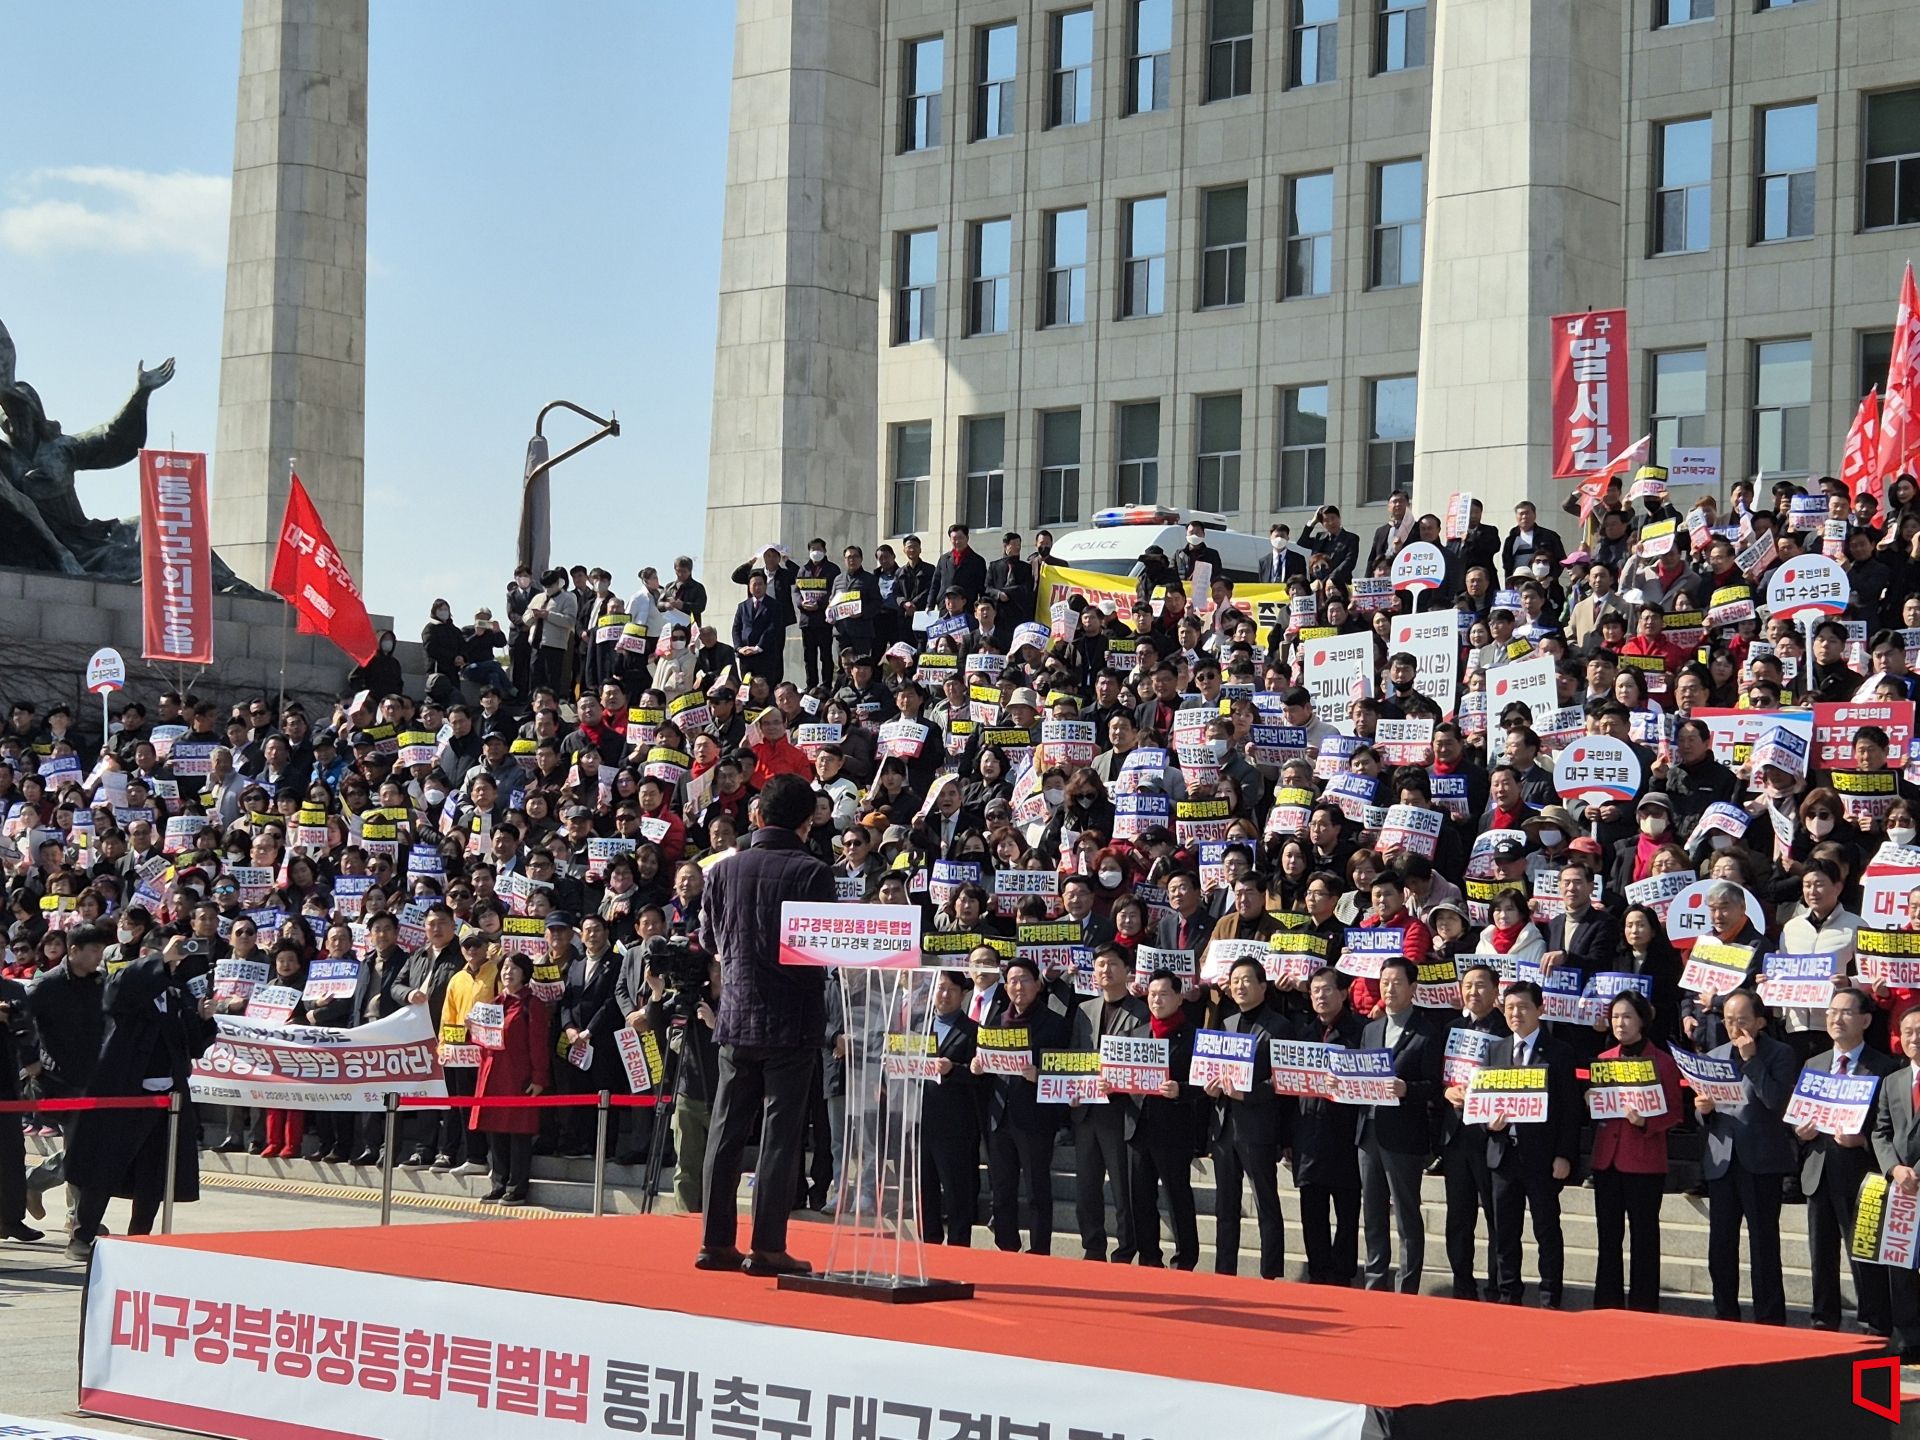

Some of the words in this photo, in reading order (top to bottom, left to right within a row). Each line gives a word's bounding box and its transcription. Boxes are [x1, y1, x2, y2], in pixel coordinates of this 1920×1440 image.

[1567, 317, 1612, 336] 대구
[1568, 338, 1612, 471] 달서갑
[284, 522, 316, 555] 대구
[1070, 541, 1118, 551] POLICE
[1399, 566, 1412, 576] 대구
[1415, 565, 1437, 576] 중남구
[1797, 567, 1831, 579] 국민의힘
[1775, 588, 1796, 602] 대구
[1798, 582, 1841, 600] 수성구을
[1722, 604, 1752, 621] 추진하라
[1415, 625, 1449, 639] 국민의힘
[1329, 648, 1364, 662] 국민의힘
[1416, 653, 1451, 674] 시(갑)
[1310, 677, 1350, 699] 구미시(
[1512, 674, 1546, 689] 국민의힘
[1555, 710, 1583, 730] 조장하는
[1848, 708, 1891, 720] 국민의힘
[1068, 724, 1095, 740] 조장하는
[1254, 730, 1278, 744] 광주전남
[1378, 722, 1405, 740] 국민분열
[1405, 724, 1431, 740] 조장하는
[1192, 748, 1216, 765] 조장하는
[1587, 750, 1622, 762] 국민의힘
[1821, 745, 1901, 760] 당원회
[1565, 767, 1589, 782] 대구
[1593, 767, 1629, 783] 북구을
[1179, 823, 1193, 839] 즉시
[1407, 810, 1438, 834] 조장하는
[997, 873, 1025, 892] 국민분열
[1027, 873, 1057, 891] 조장하는
[1660, 874, 1693, 898] 조장하는
[1133, 884, 1167, 903] 광주전남
[788, 917, 912, 936] 대구경북행정통합특별법
[1679, 913, 1706, 929] 대구
[503, 937, 518, 952] 즉시
[788, 934, 807, 948] 통과
[810, 936, 829, 948] 촉구
[831, 937, 869, 950] 대구경북
[873, 938, 912, 951] 결의대회
[1347, 931, 1373, 949] 광주전남
[1161, 953, 1192, 972] 조장하는
[1283, 957, 1325, 977] 추진하라
[1766, 957, 1800, 977] 광주전남
[1860, 957, 1878, 980] 즉시
[239, 964, 267, 981] 조장하는
[1685, 964, 1704, 986] 즉시
[1419, 986, 1459, 1004] 추진하라
[1779, 983, 1793, 1001] 경북
[619, 1030, 635, 1049] 즉시
[1197, 1033, 1222, 1055] 광주전남
[272, 1049, 339, 1078] 특별법
[342, 1045, 433, 1078] 승인하라
[1103, 1041, 1131, 1063] 국민분열
[1133, 1042, 1166, 1065] 조장하는
[1272, 1042, 1305, 1064] 국민분열
[625, 1050, 650, 1091] 추진하라
[1102, 1067, 1132, 1090] 민주당은
[1133, 1069, 1164, 1092] 각성하라
[1473, 1069, 1547, 1091] 대구경북행정통합특별법
[1041, 1079, 1062, 1099] 즉시
[1066, 1079, 1106, 1099] 추진하라
[1274, 1070, 1307, 1092] 민주당은
[1800, 1072, 1838, 1099] 광주전남
[363, 1092, 379, 1102] 장소
[1593, 1091, 1617, 1113] 즉시
[1619, 1089, 1661, 1112] 추진하라
[1468, 1098, 1490, 1117] 즉시
[1493, 1097, 1543, 1118] 추진하라
[1791, 1099, 1812, 1120] 대구
[1883, 1236, 1912, 1263] 즉시
[110, 1287, 592, 1425] 대구경북행정통합특별법
[602, 1359, 703, 1440] 통과
[710, 1375, 813, 1440] 촉구
